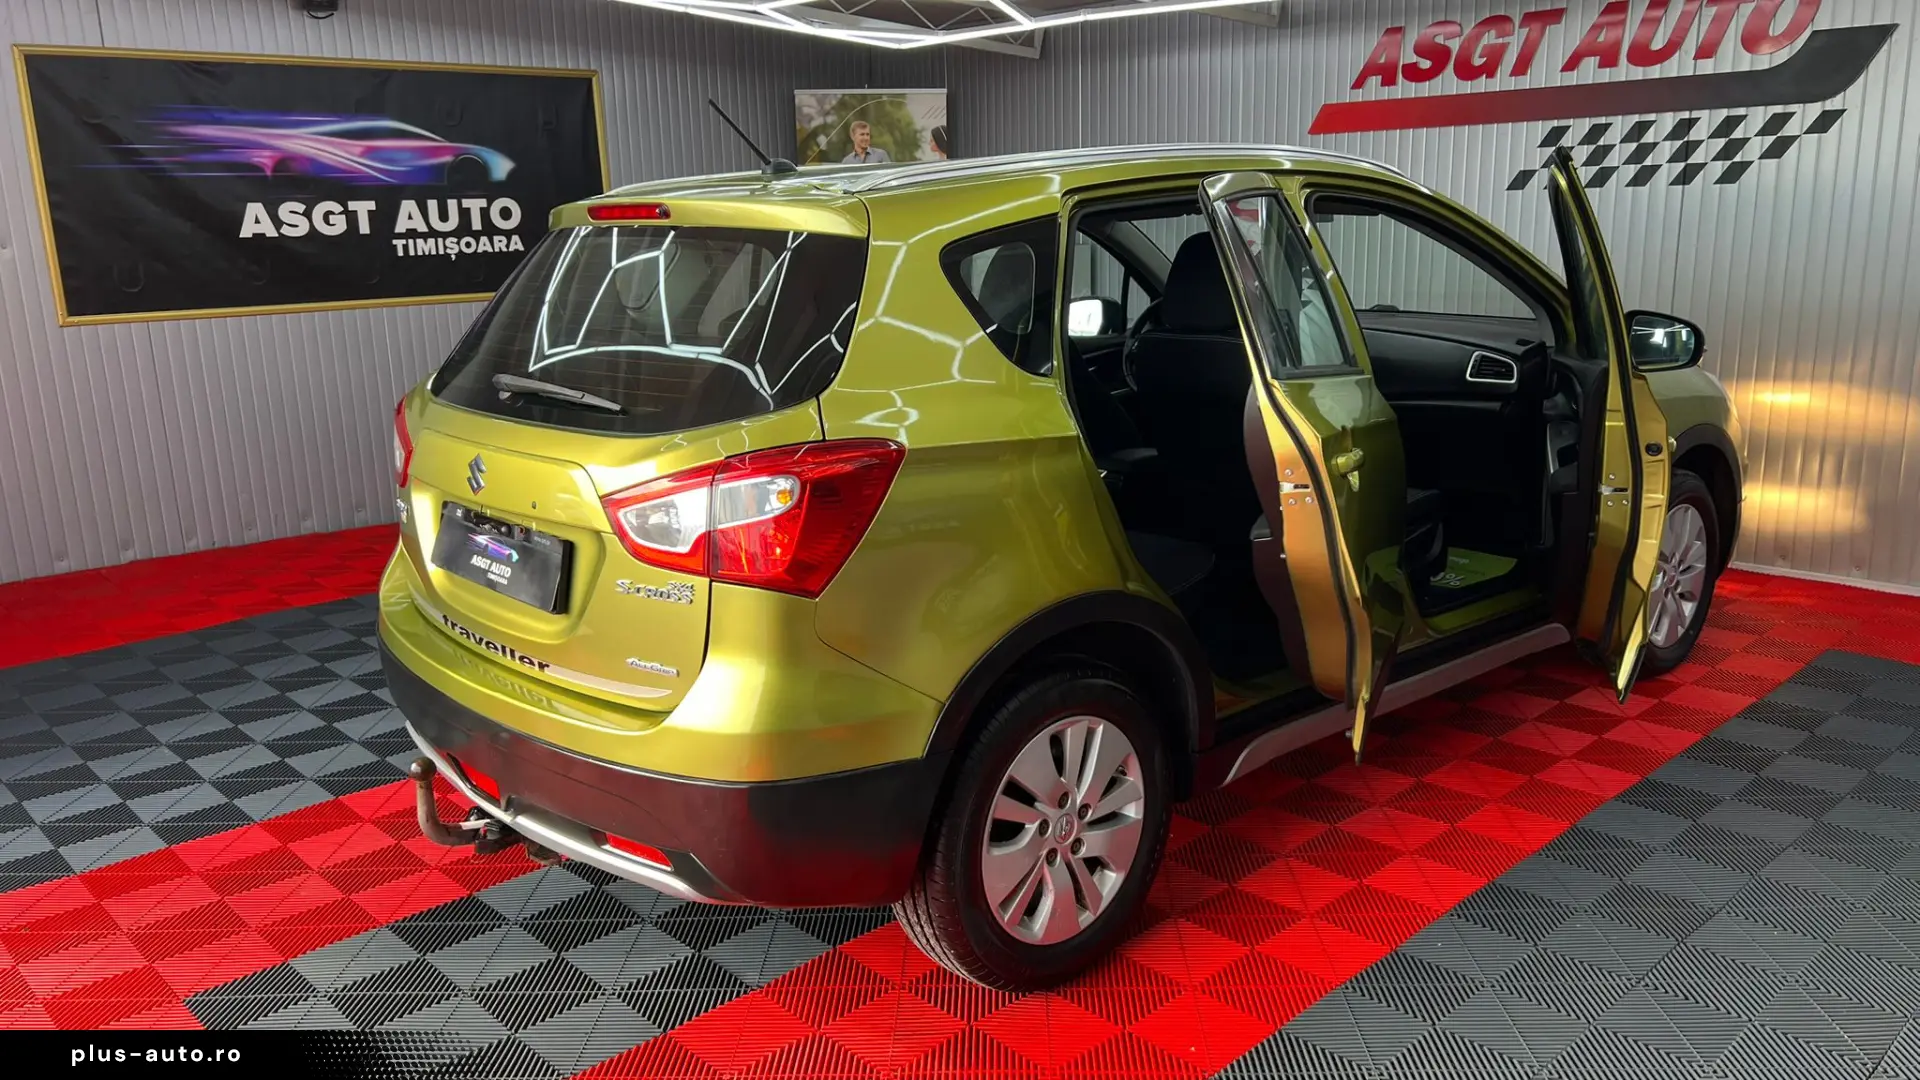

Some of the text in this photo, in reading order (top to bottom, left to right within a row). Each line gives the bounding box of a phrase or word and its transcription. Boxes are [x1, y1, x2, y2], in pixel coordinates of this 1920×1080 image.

[1350, 0, 1821, 90] ASGT AUTO
[239, 197, 522, 238] ASGT AUTO
[392, 234, 525, 260] TIMIȘOARA
[470, 554, 512, 578] ASGT AUTO
[442, 614, 549, 673] traveller
